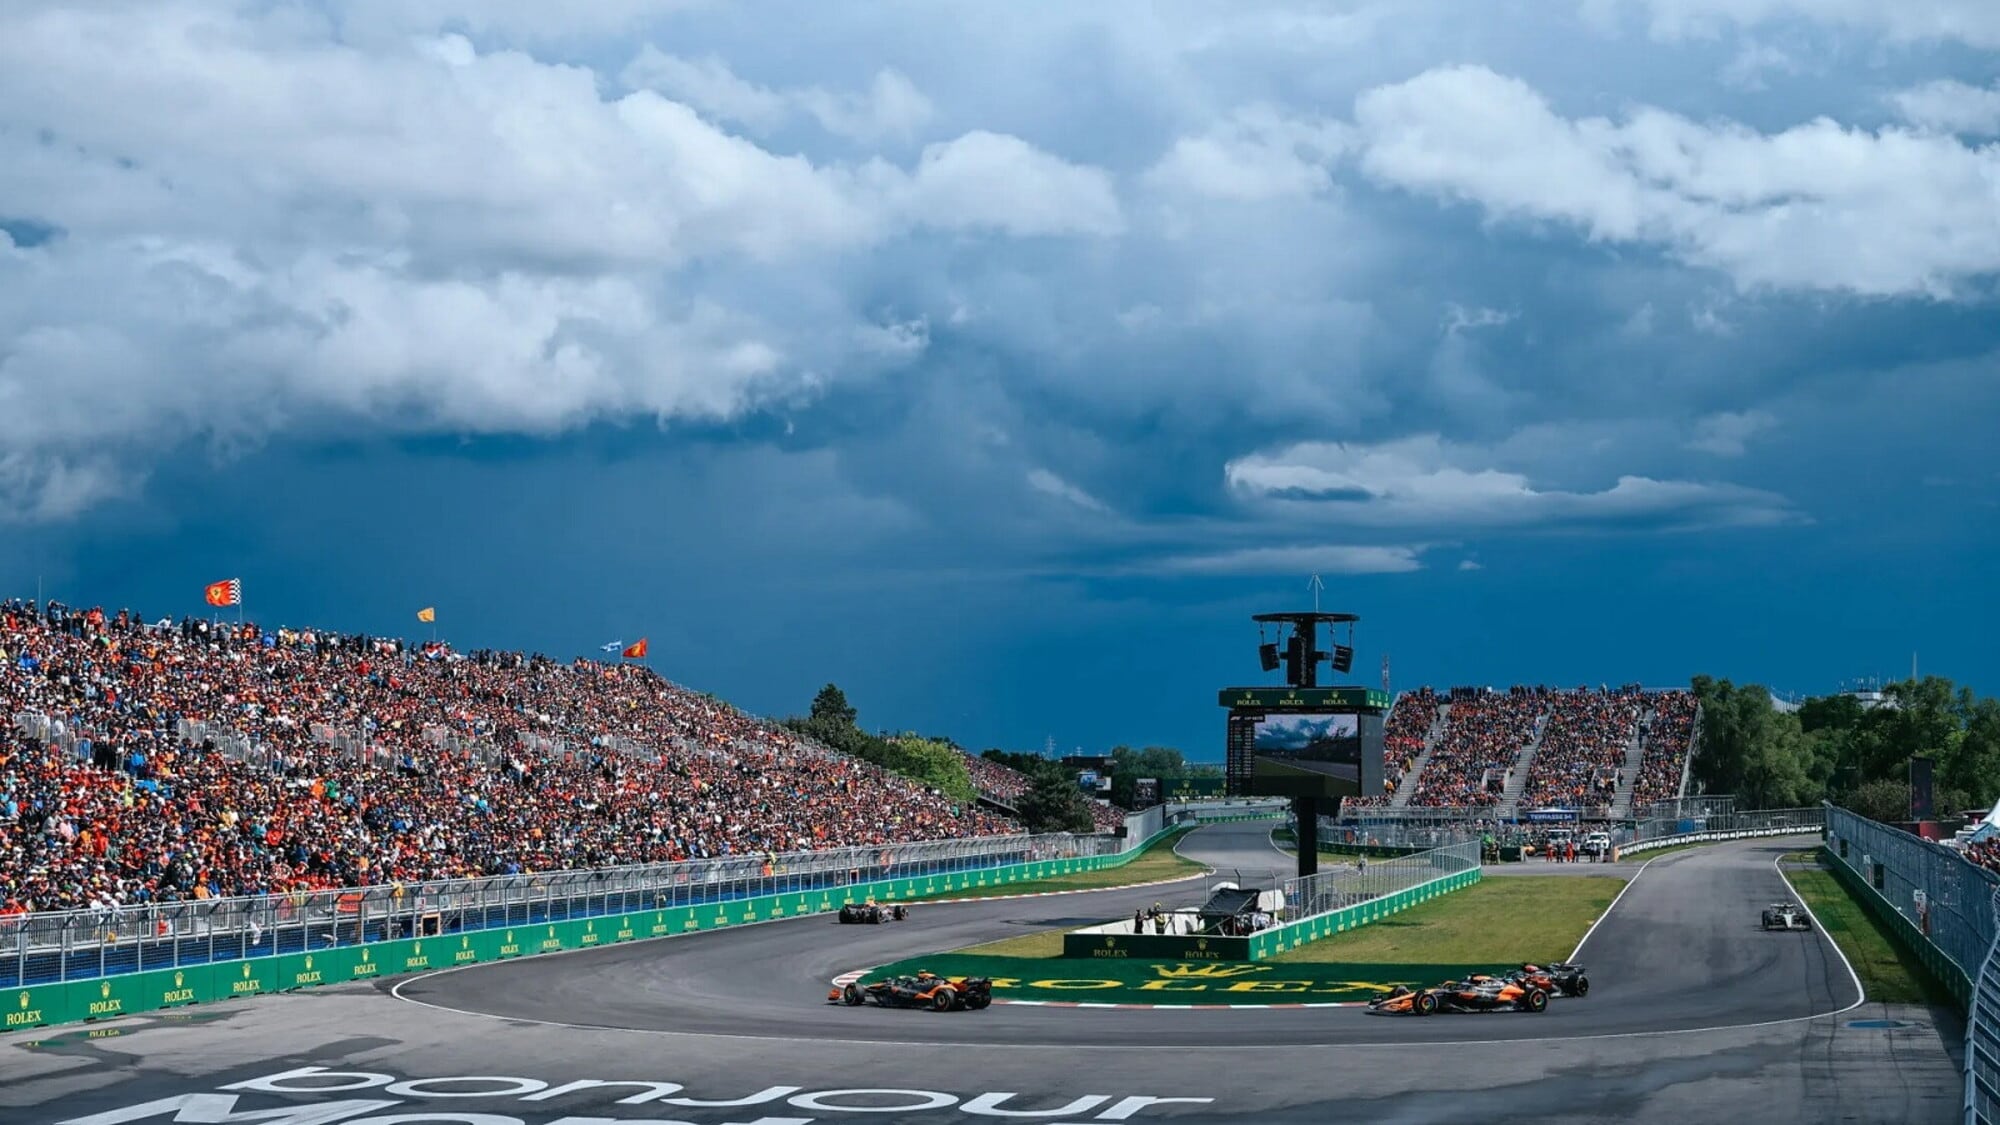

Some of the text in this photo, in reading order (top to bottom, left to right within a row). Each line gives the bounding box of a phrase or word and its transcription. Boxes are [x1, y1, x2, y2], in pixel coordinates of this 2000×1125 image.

[455, 949, 475, 961] ROLEX
[500, 943, 519, 955] ROLEX
[1093, 948, 1128, 958] ROLEX
[1184, 950, 1220, 960] ROLEX
[406, 955, 428, 967] ROLEX
[354, 963, 377, 975] ROLEX
[296, 970, 322, 984] ROLEX
[233, 979, 260, 993] ROLEX
[164, 988, 194, 1003] ROLEX
[90, 999, 121, 1014] ROLEX
[6, 1010, 41, 1026] ROLEX
